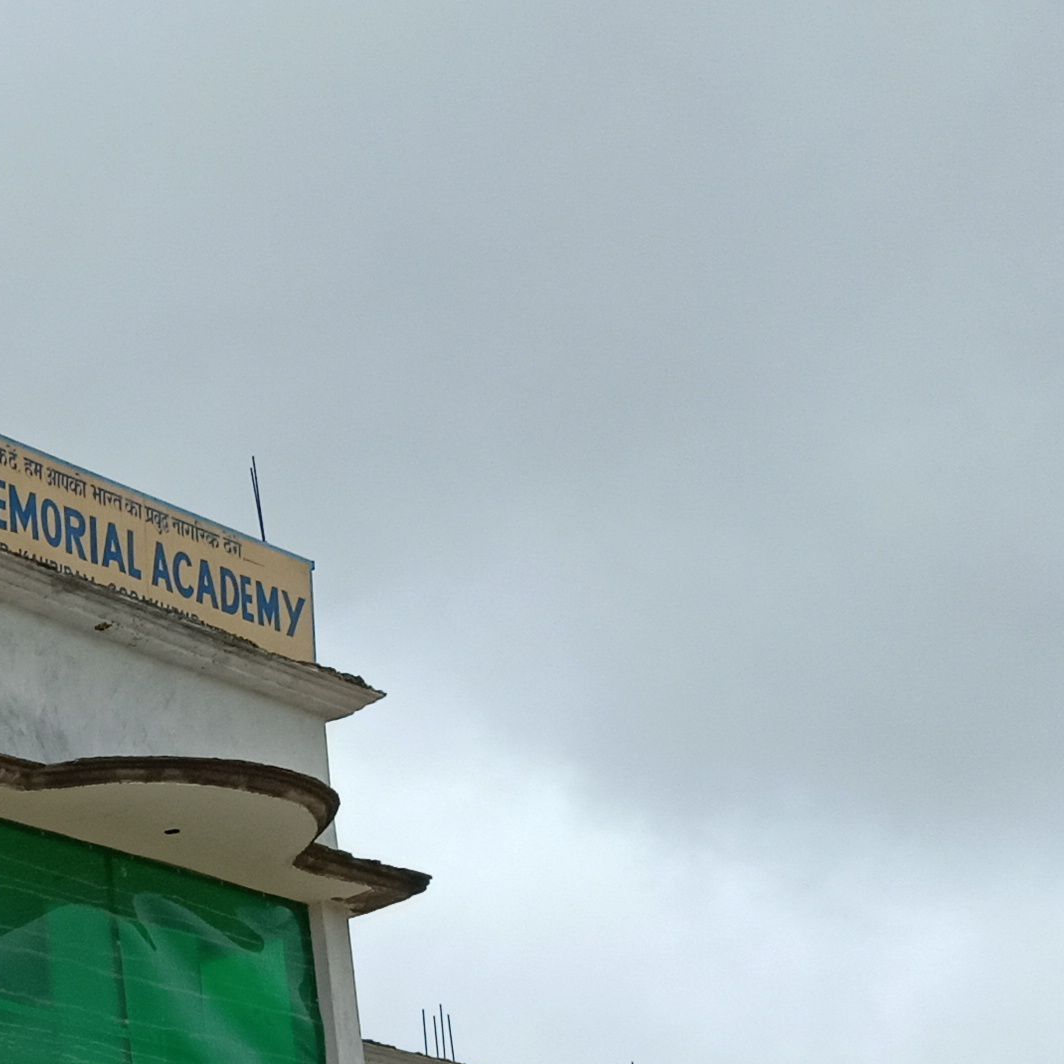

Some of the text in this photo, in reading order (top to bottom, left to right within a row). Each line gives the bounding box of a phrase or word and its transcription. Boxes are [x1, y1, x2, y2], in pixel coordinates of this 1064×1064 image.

[24, 457, 43, 480] हम
[91, 484, 123, 512] भारत
[125, 498, 142, 519] का
[152, 541, 306, 637] ACADEMY
